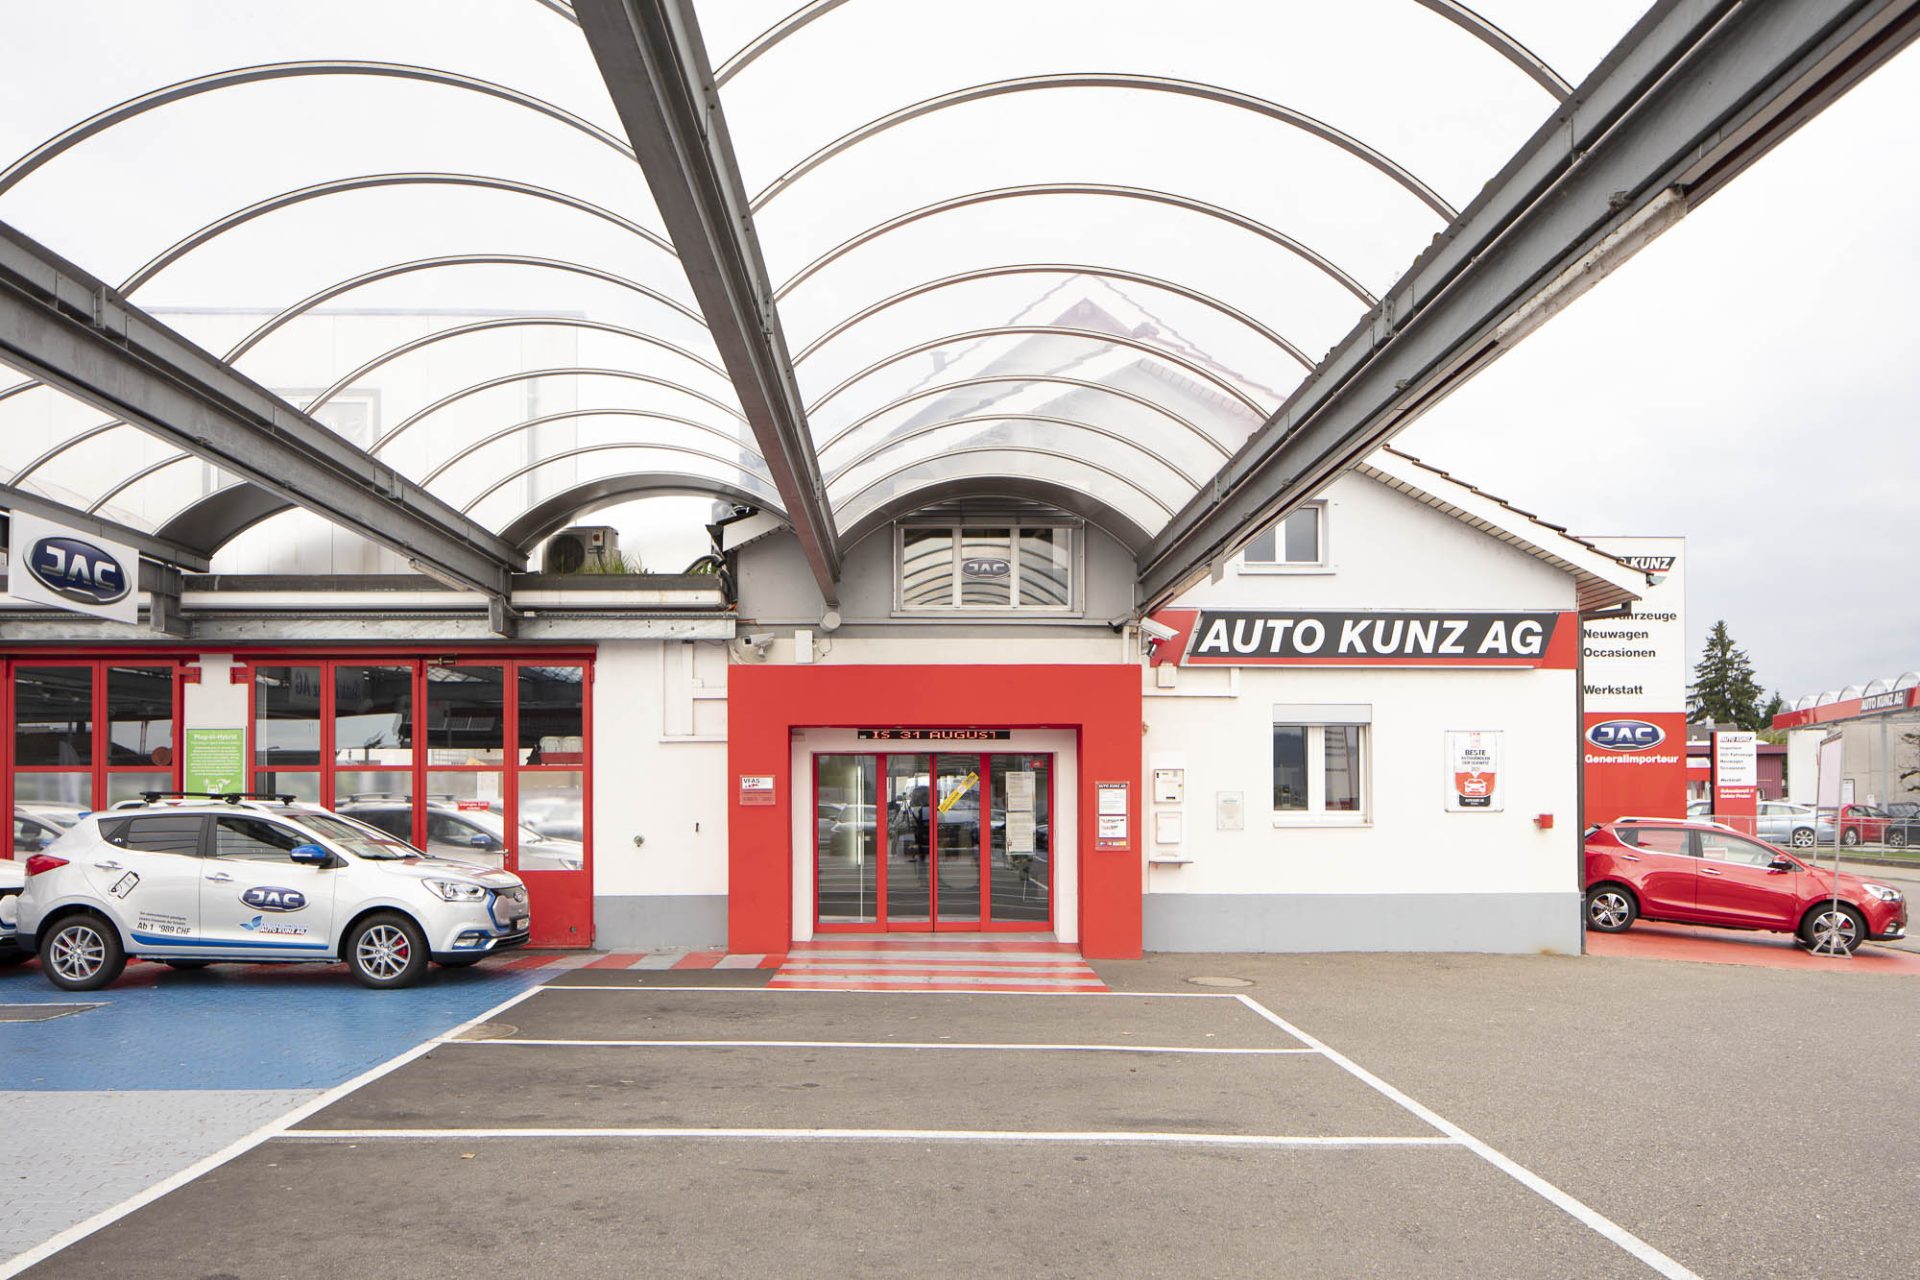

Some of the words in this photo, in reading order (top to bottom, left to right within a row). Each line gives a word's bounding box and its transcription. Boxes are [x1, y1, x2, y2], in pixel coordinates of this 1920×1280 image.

[40, 545, 116, 592] JAC
[968, 563, 1005, 575] JAC
[1630, 557, 1671, 570] KUNZ
[1198, 618, 1326, 654] AUTO
[1337, 619, 1469, 654] KUNZ
[1477, 619, 1544, 655] AG
[1584, 629, 1649, 641] Neuwagen
[1584, 647, 1656, 658] Occasionen
[1584, 685, 1643, 695] Werkstatt
[900, 731, 920, 739] 31
[1597, 727, 1653, 742] JAC
[248, 890, 300, 907] JAC
[137, 921, 148, 930] Ab
[176, 926, 191, 935] CHF
